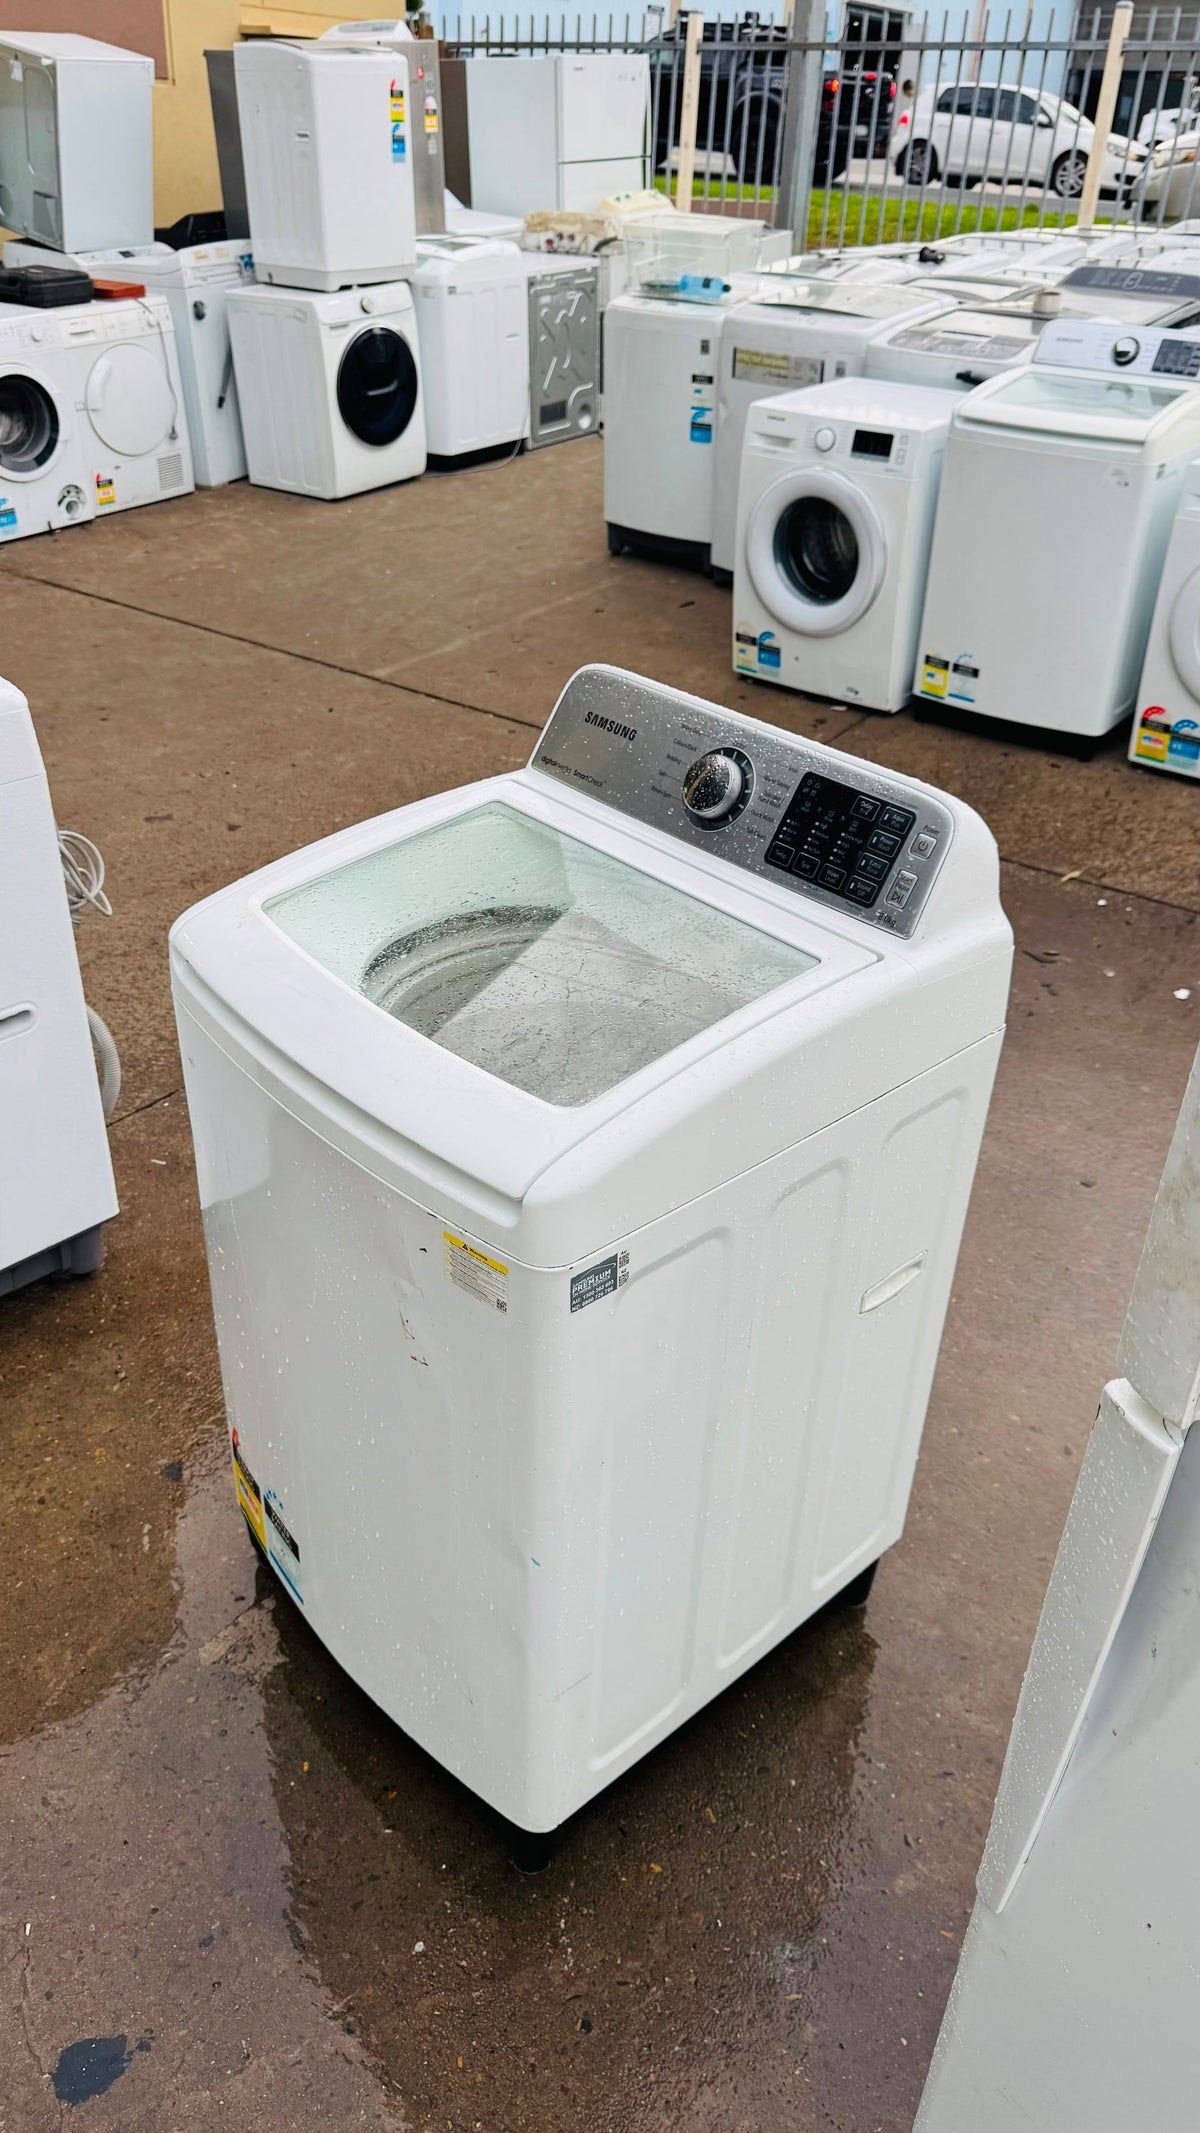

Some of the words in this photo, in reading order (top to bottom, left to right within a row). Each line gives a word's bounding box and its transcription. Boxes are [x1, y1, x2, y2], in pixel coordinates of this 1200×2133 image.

[585, 711, 637, 741] SAMSUNG
[878, 912, 897, 928] 8.0kg
[573, 1268, 611, 1294] PREMIUM
